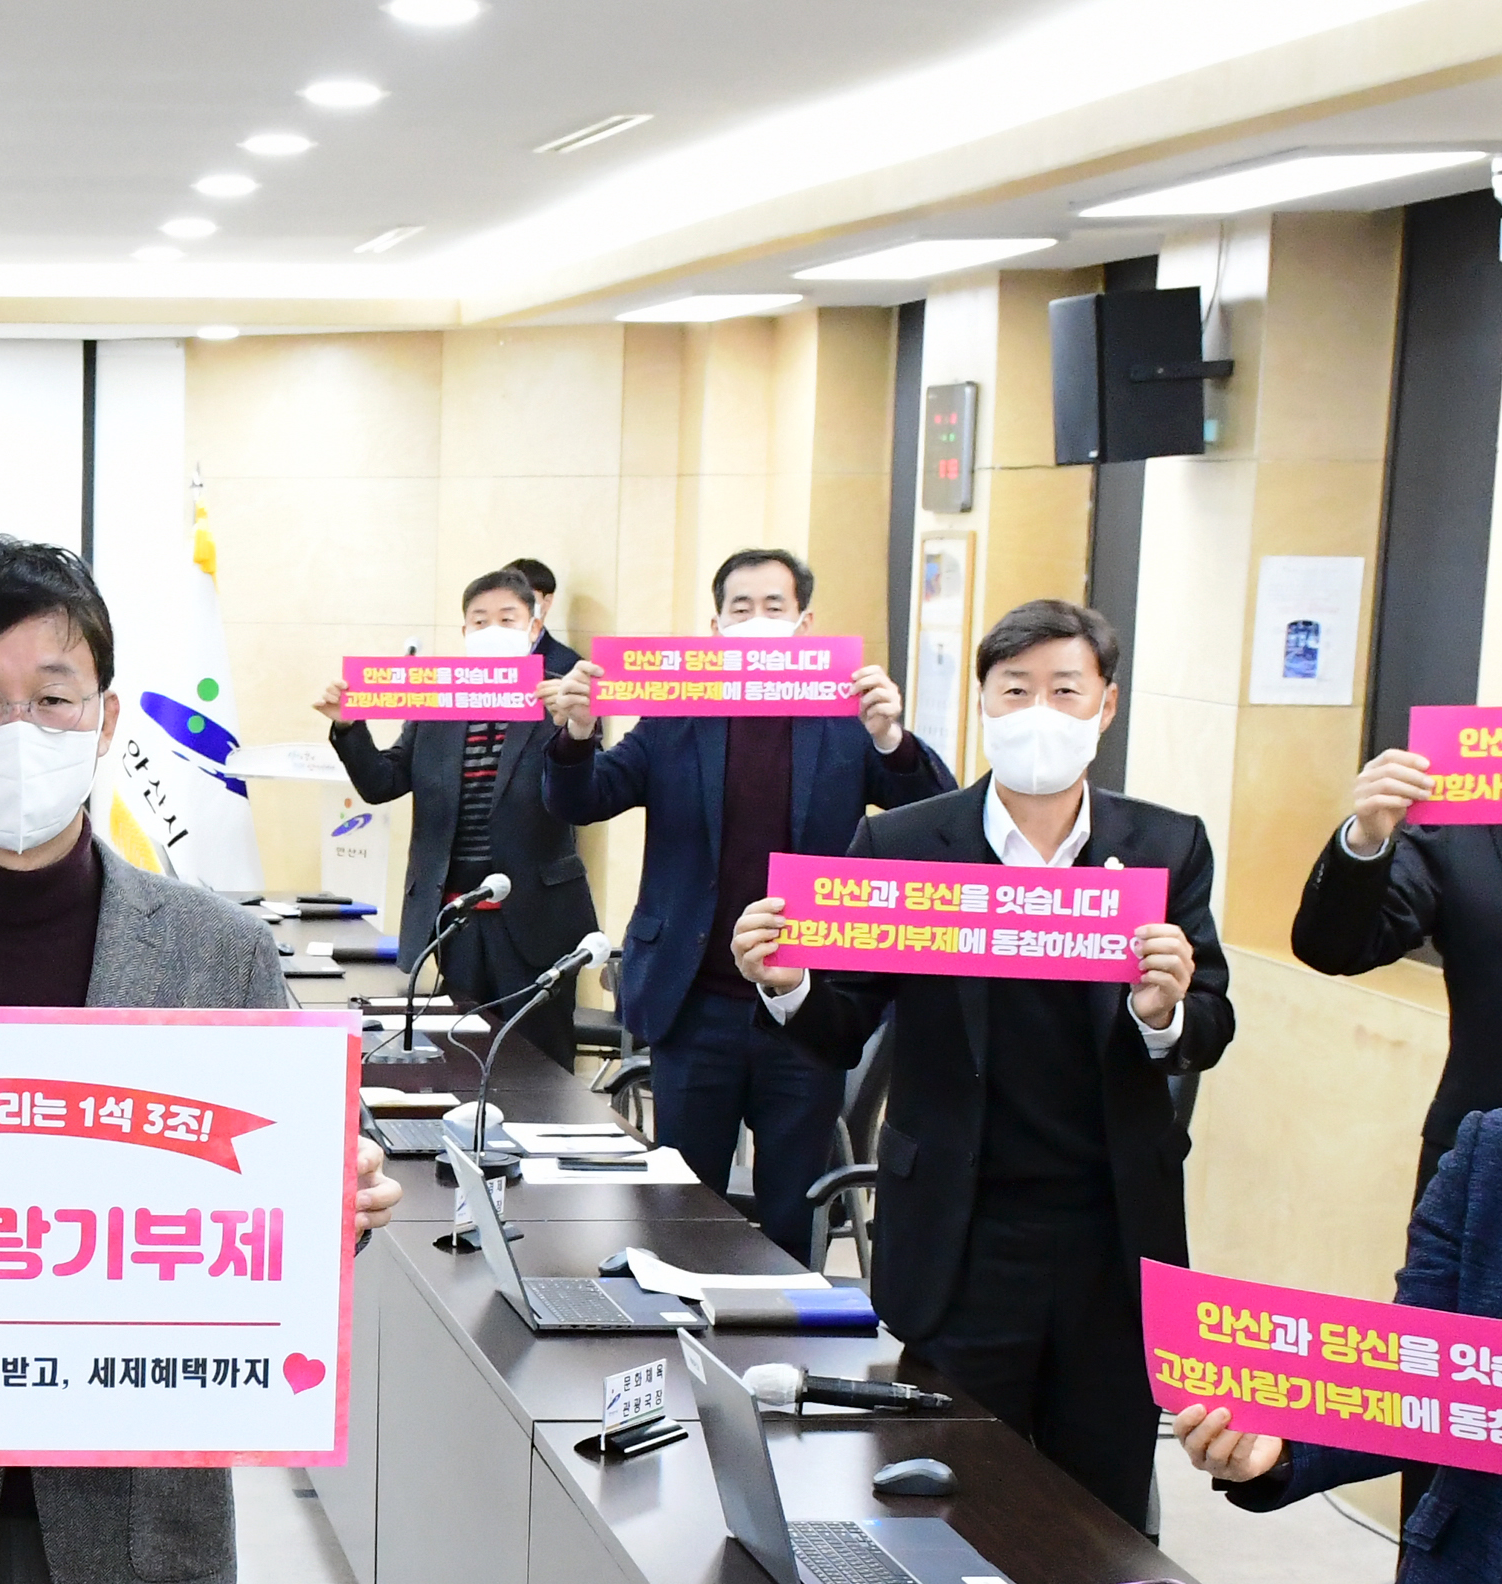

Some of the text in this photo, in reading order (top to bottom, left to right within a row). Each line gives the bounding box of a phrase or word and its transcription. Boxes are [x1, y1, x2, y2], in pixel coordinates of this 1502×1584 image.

[363, 667, 518, 684] 안산과 당신을 잇습니다!
[624, 650, 830, 671] 안산과 당신을 잇습니다!
[345, 692, 526, 708] 고향사랑기부제에 동참하세요
[597, 681, 840, 700] 고향사랑기부제에 동참하세요
[123, 740, 189, 848] 안산시
[814, 878, 1119, 917] 안산과 당신을 잇습니다!
[777, 916, 1127, 959] 고향사랑기부제에 동참하세요
[79, 1097, 133, 1132] 1석
[144, 1105, 213, 1142] 3조!
[1197, 1302, 1312, 1356] 안산과
[1320, 1323, 1440, 1377] 당신을
[2, 1357, 68, 1389] 받고,
[88, 1357, 269, 1388] 세제혜택까지
[1155, 1348, 1440, 1434] 고향사랑기부제에
